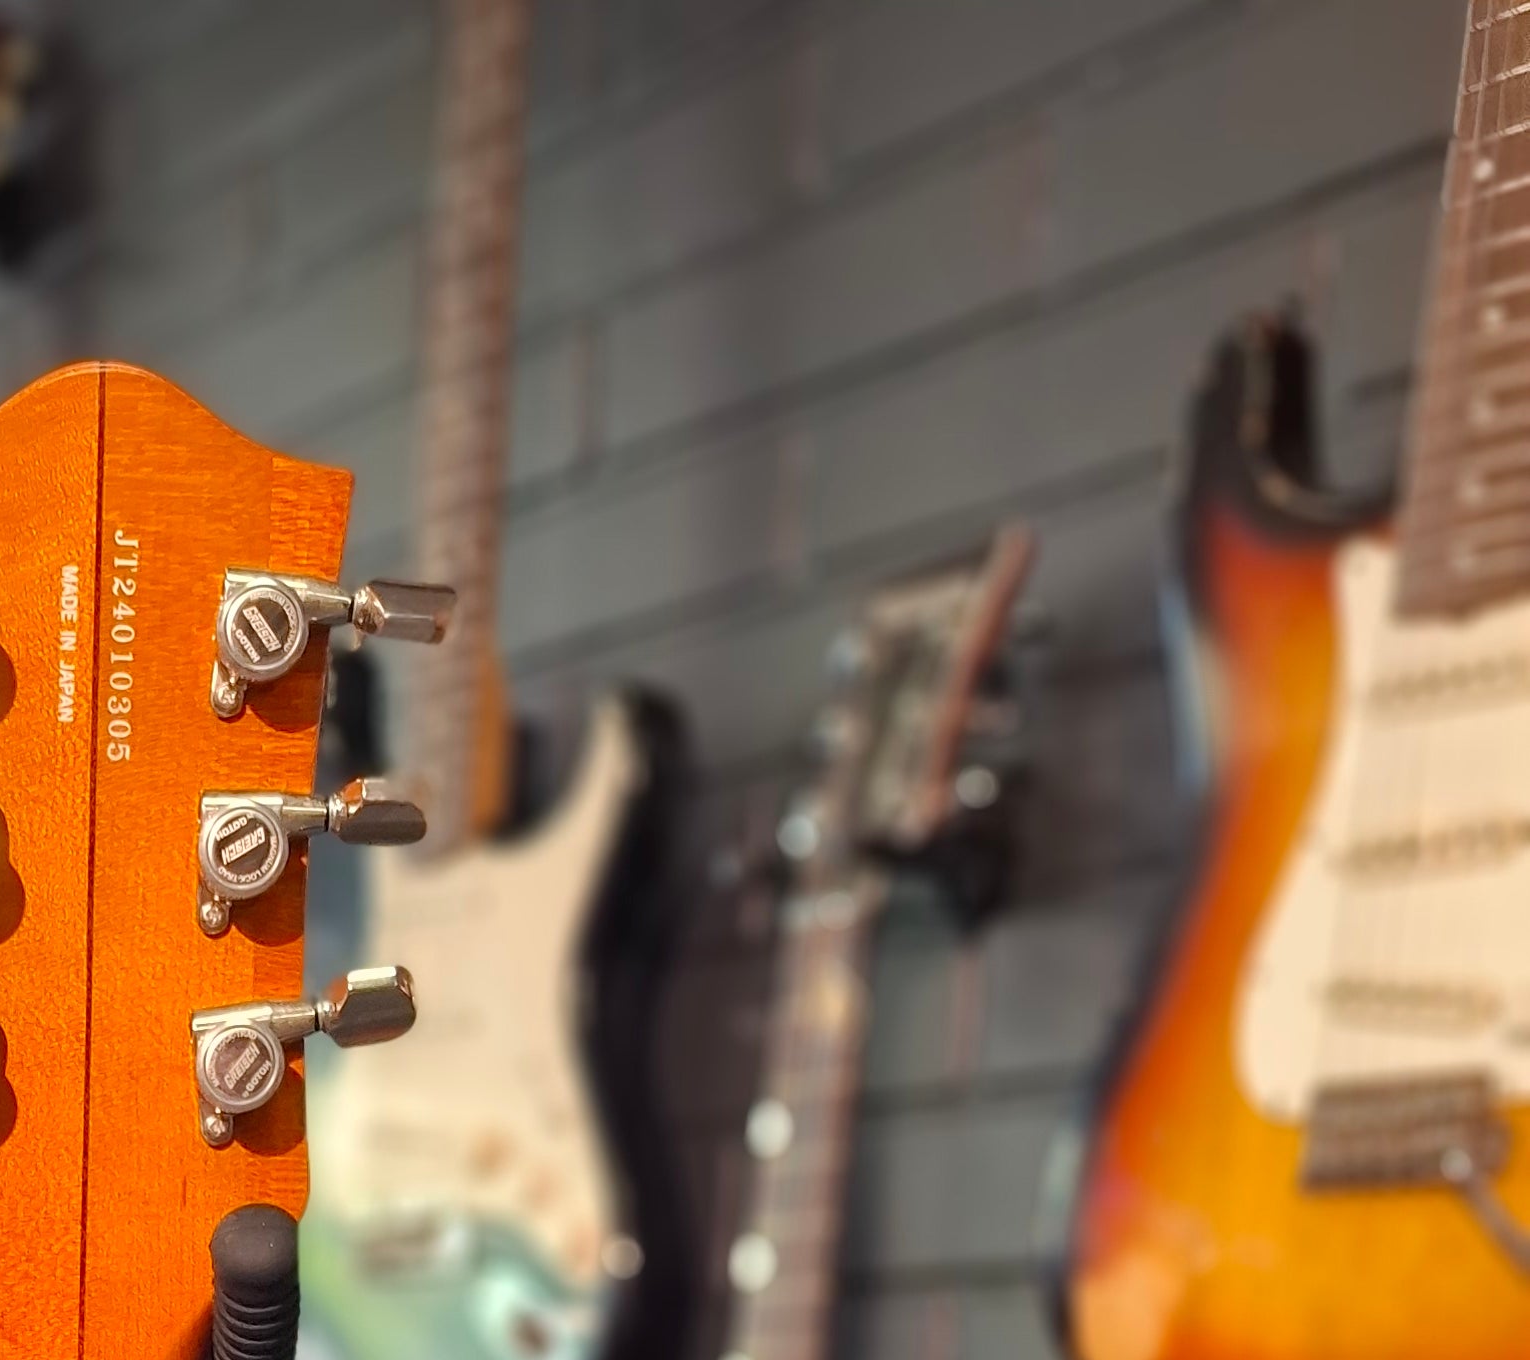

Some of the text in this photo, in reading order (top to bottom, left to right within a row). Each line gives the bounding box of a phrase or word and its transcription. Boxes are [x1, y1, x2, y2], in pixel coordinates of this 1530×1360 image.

[57, 564, 79, 722] MADE IN JAPAN
[107, 529, 139, 762] JT24010305
